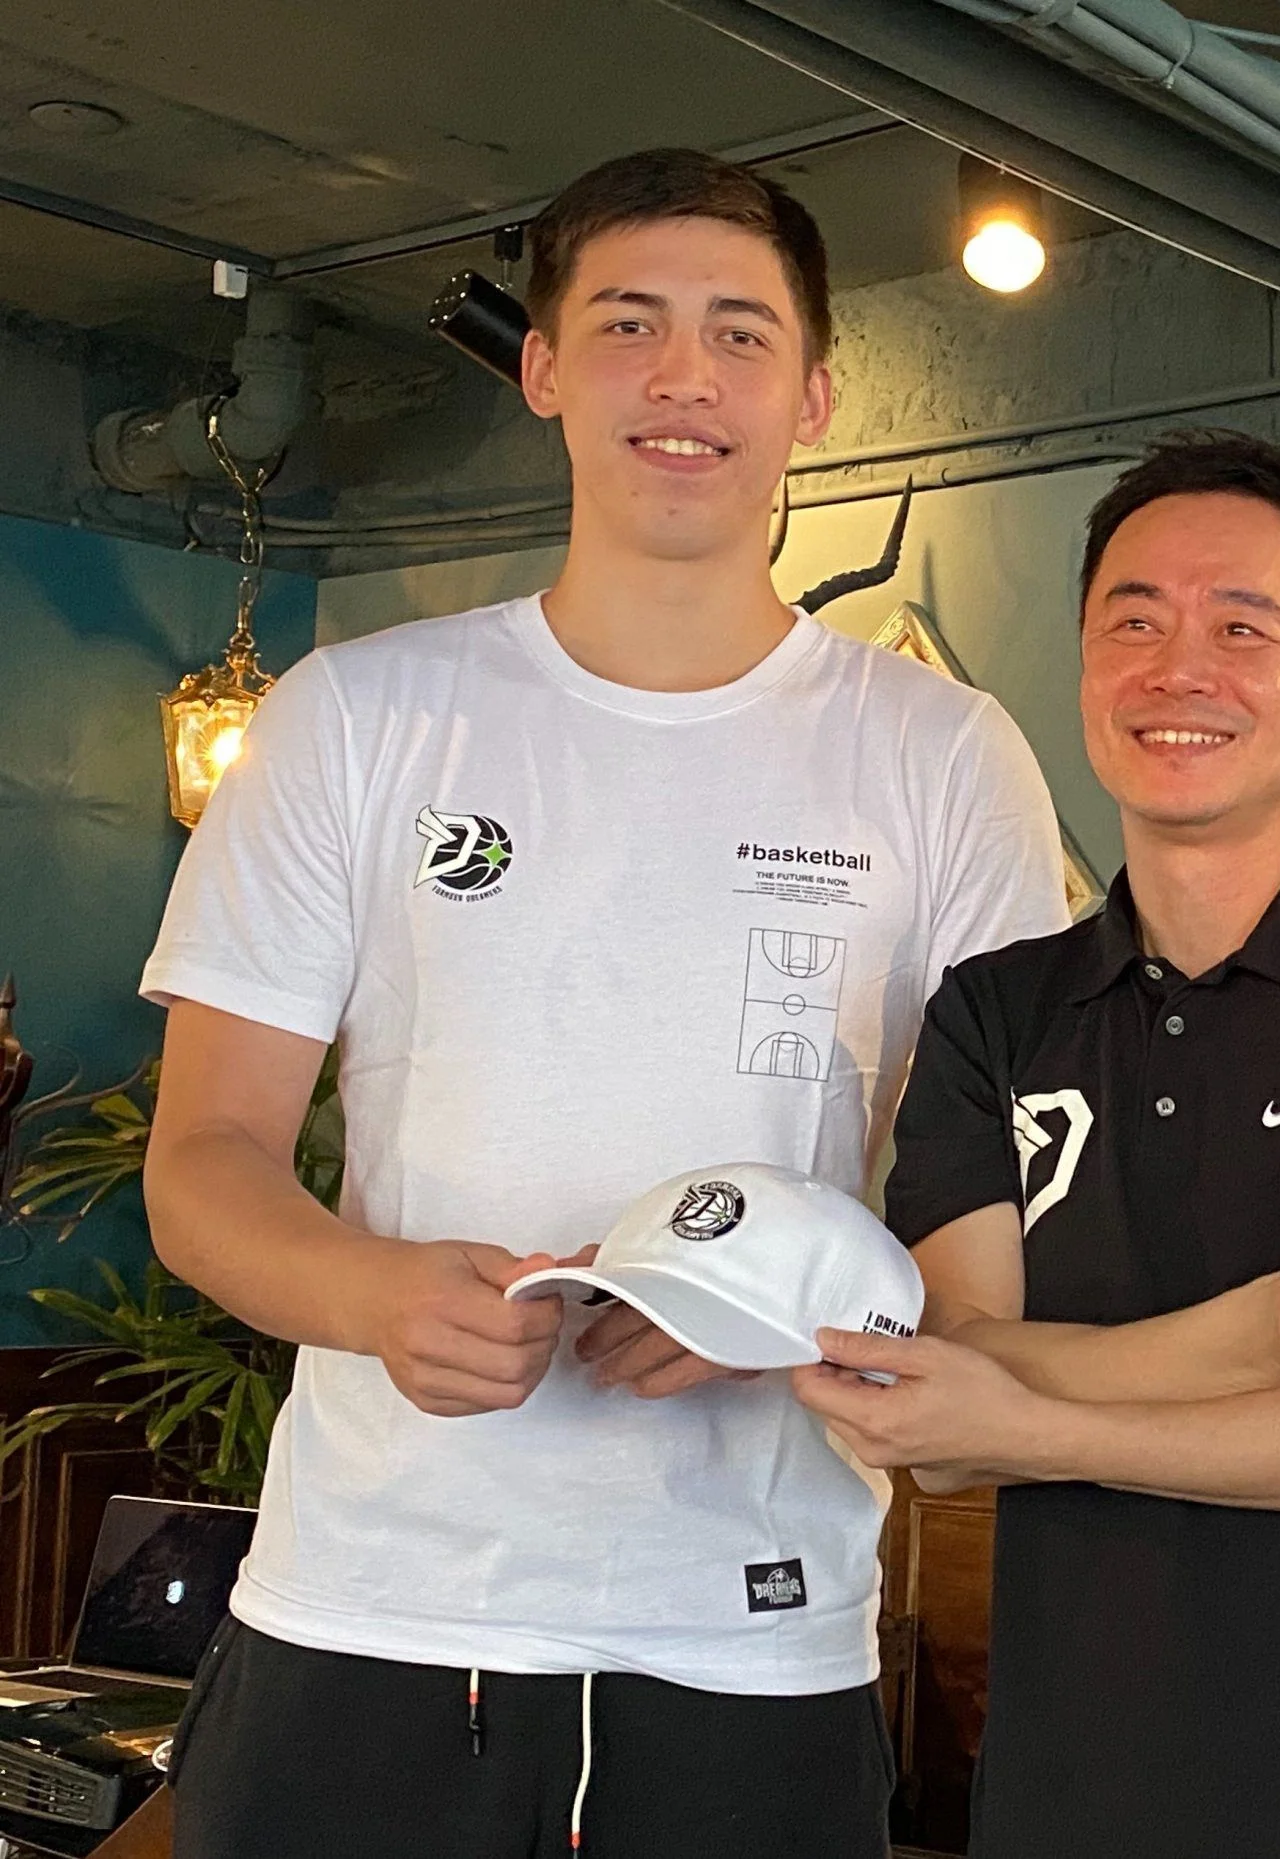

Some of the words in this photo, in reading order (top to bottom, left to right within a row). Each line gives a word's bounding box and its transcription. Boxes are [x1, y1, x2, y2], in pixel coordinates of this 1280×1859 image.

[736, 842, 871, 872] #basketball
[756, 871, 775, 880] THE
[777, 873, 814, 883] FUTURE
[874, 1313, 915, 1338] DREAM
